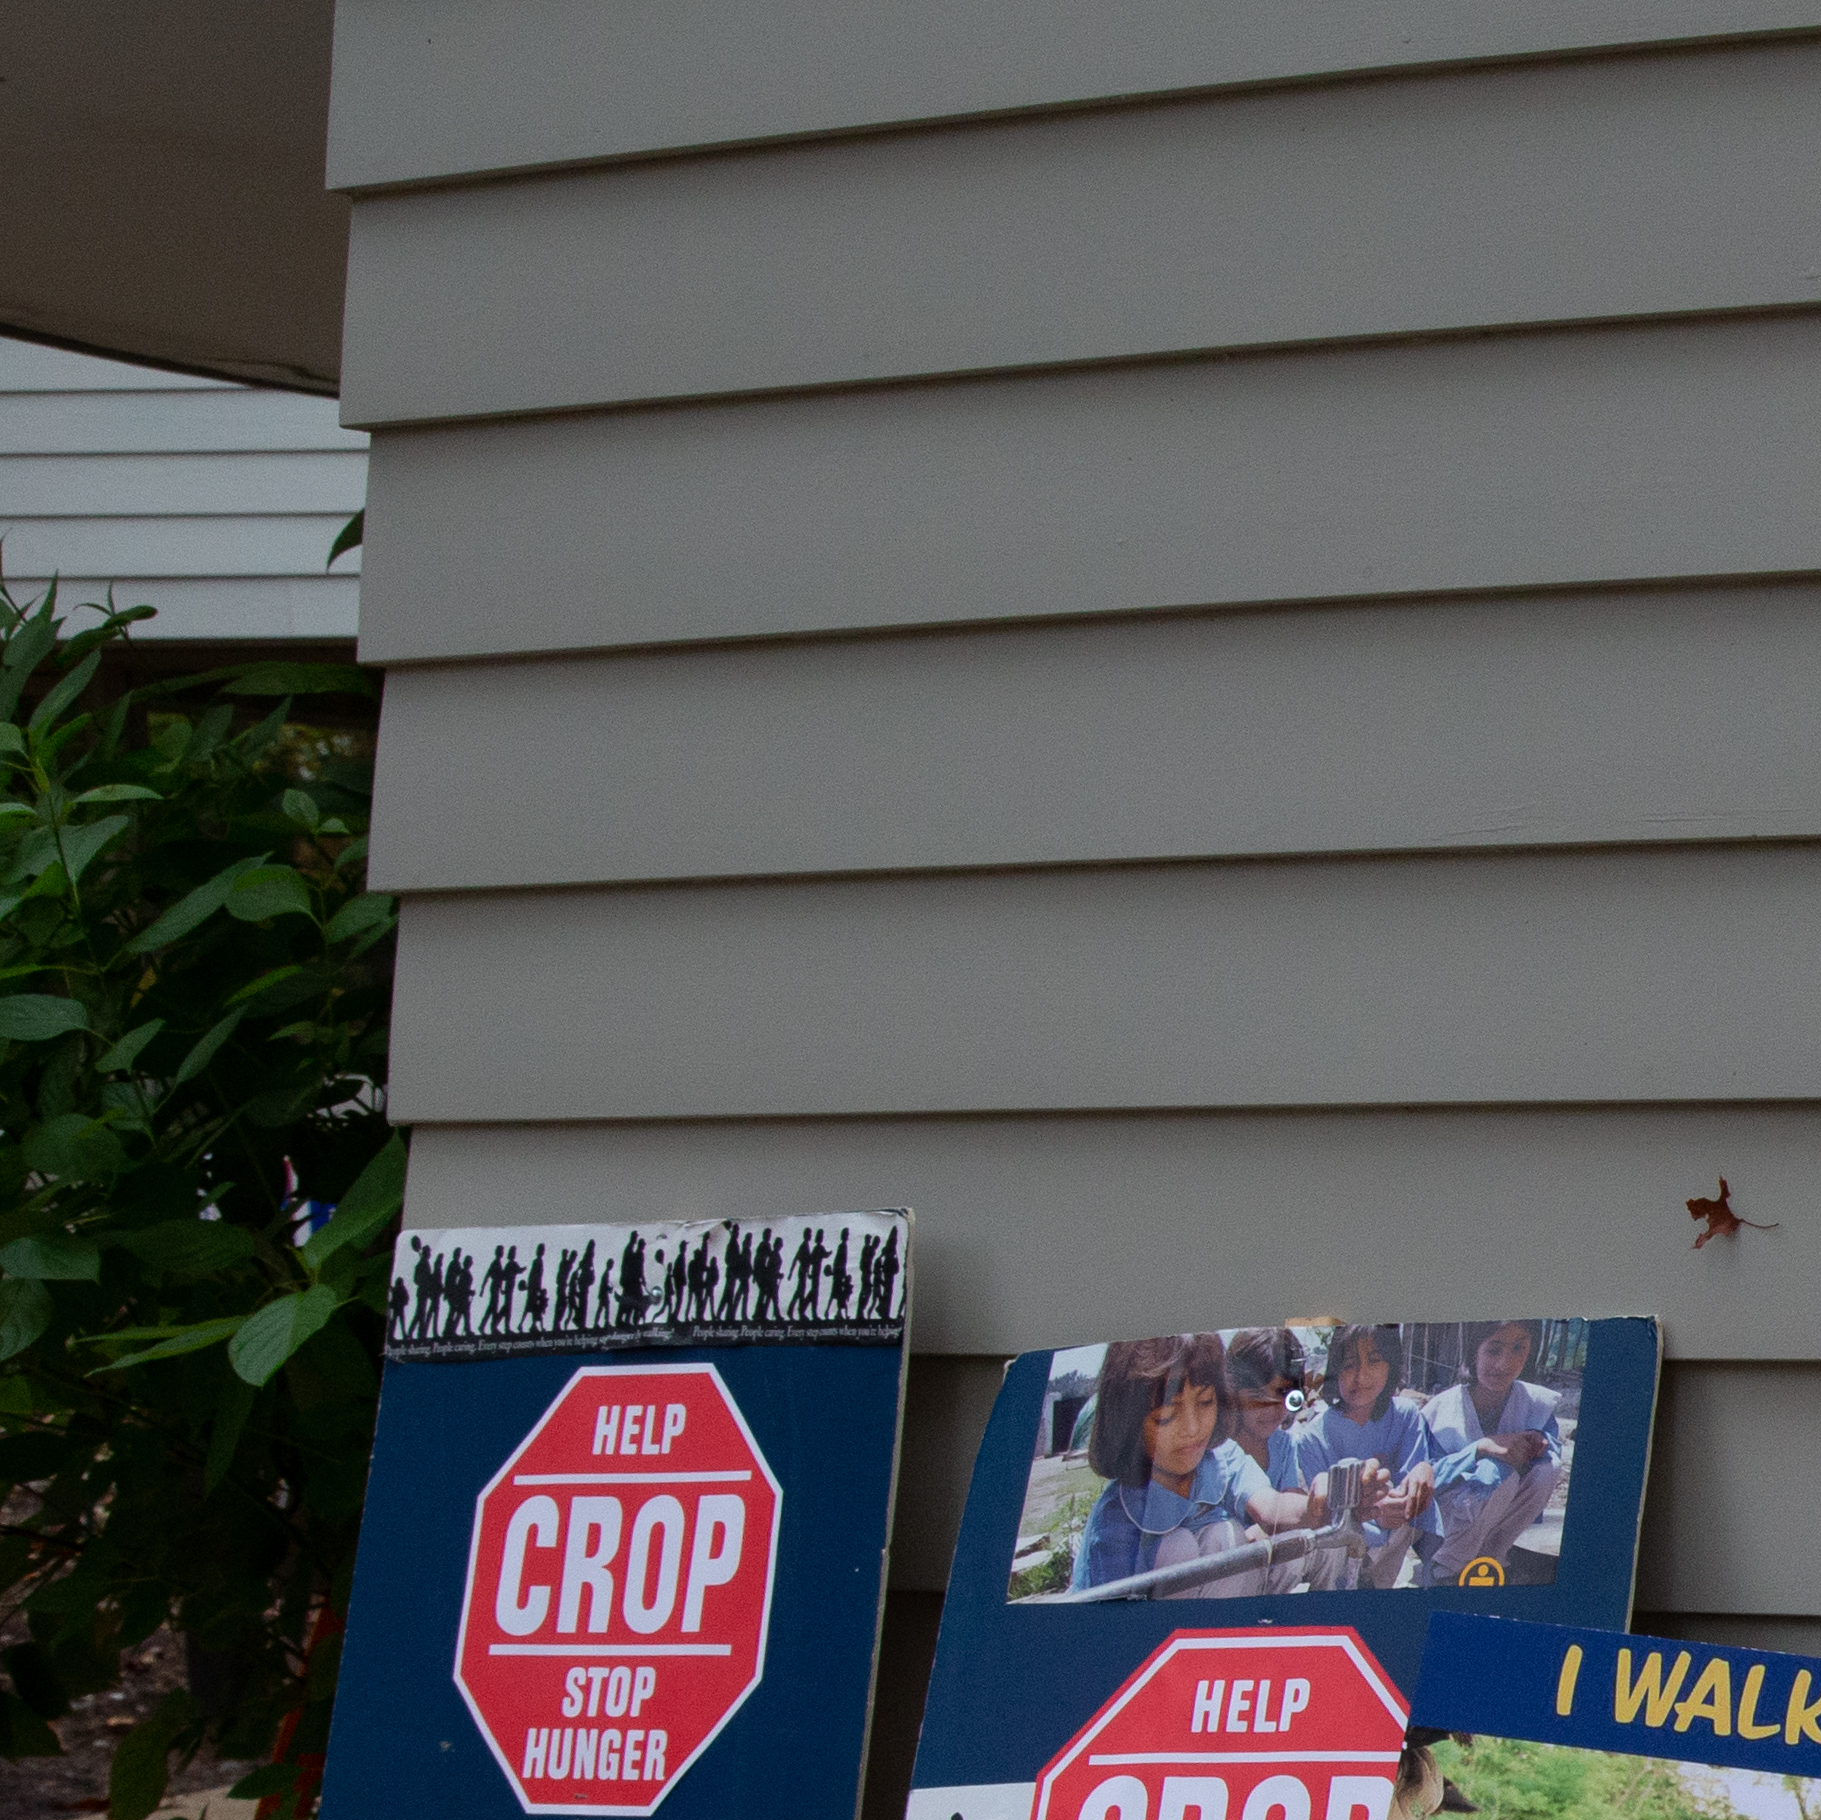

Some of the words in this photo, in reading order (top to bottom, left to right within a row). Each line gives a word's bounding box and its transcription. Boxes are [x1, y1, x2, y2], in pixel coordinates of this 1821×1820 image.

[592, 1403, 687, 1456] HELP
[494, 1493, 746, 1637] CROP
[561, 1665, 657, 1719] STOP
[1190, 1678, 1311, 1735] HELP
[1555, 1644, 1583, 1718] I
[522, 1727, 669, 1782] HUNGER
